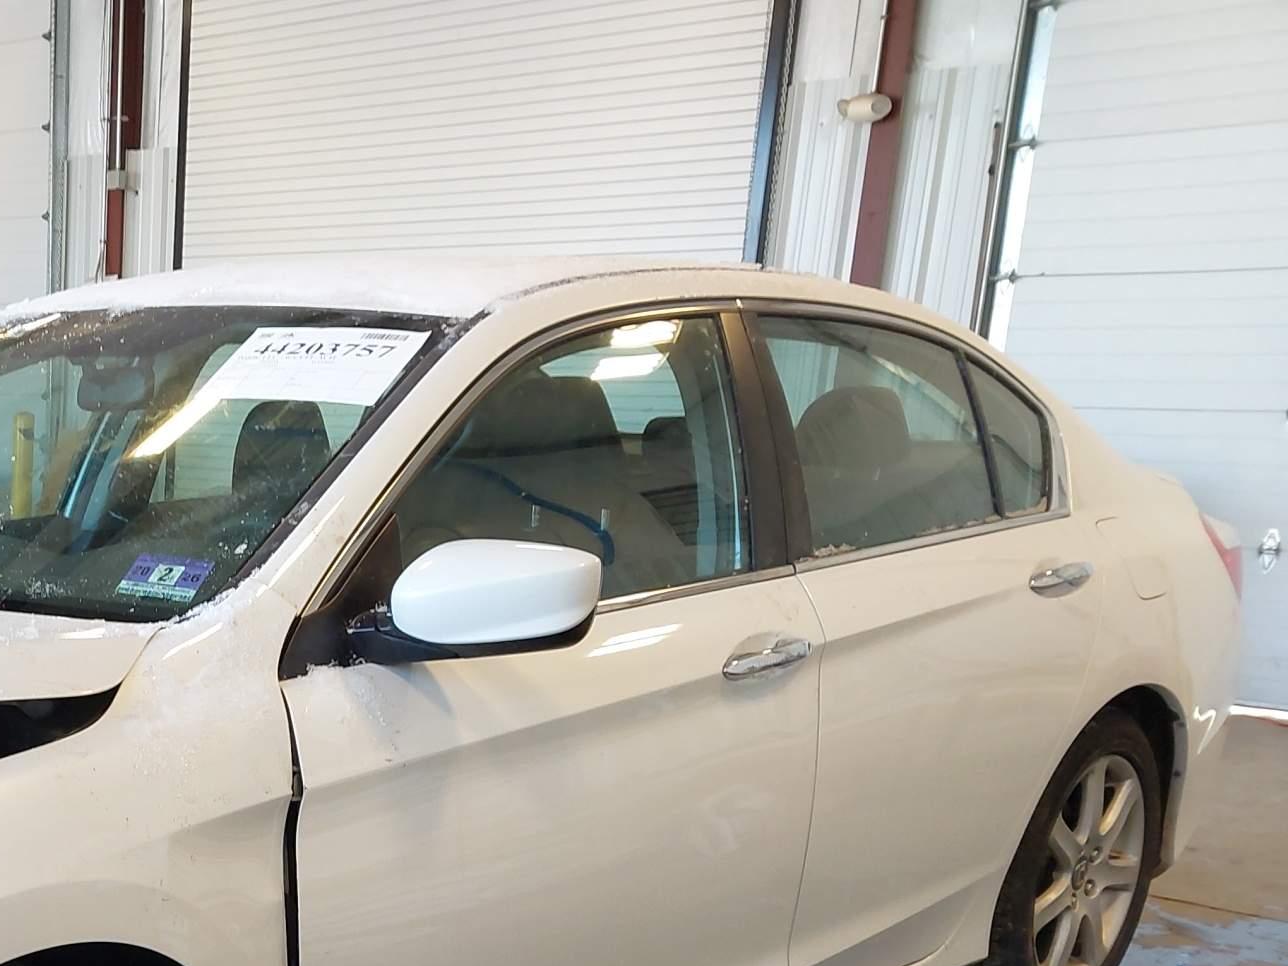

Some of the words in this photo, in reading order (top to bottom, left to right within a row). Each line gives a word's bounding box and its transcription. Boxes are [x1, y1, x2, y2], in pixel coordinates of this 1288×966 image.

[254, 342, 397, 358] 44203757
[157, 567, 174, 582] 2
[182, 572, 202, 583] 26
